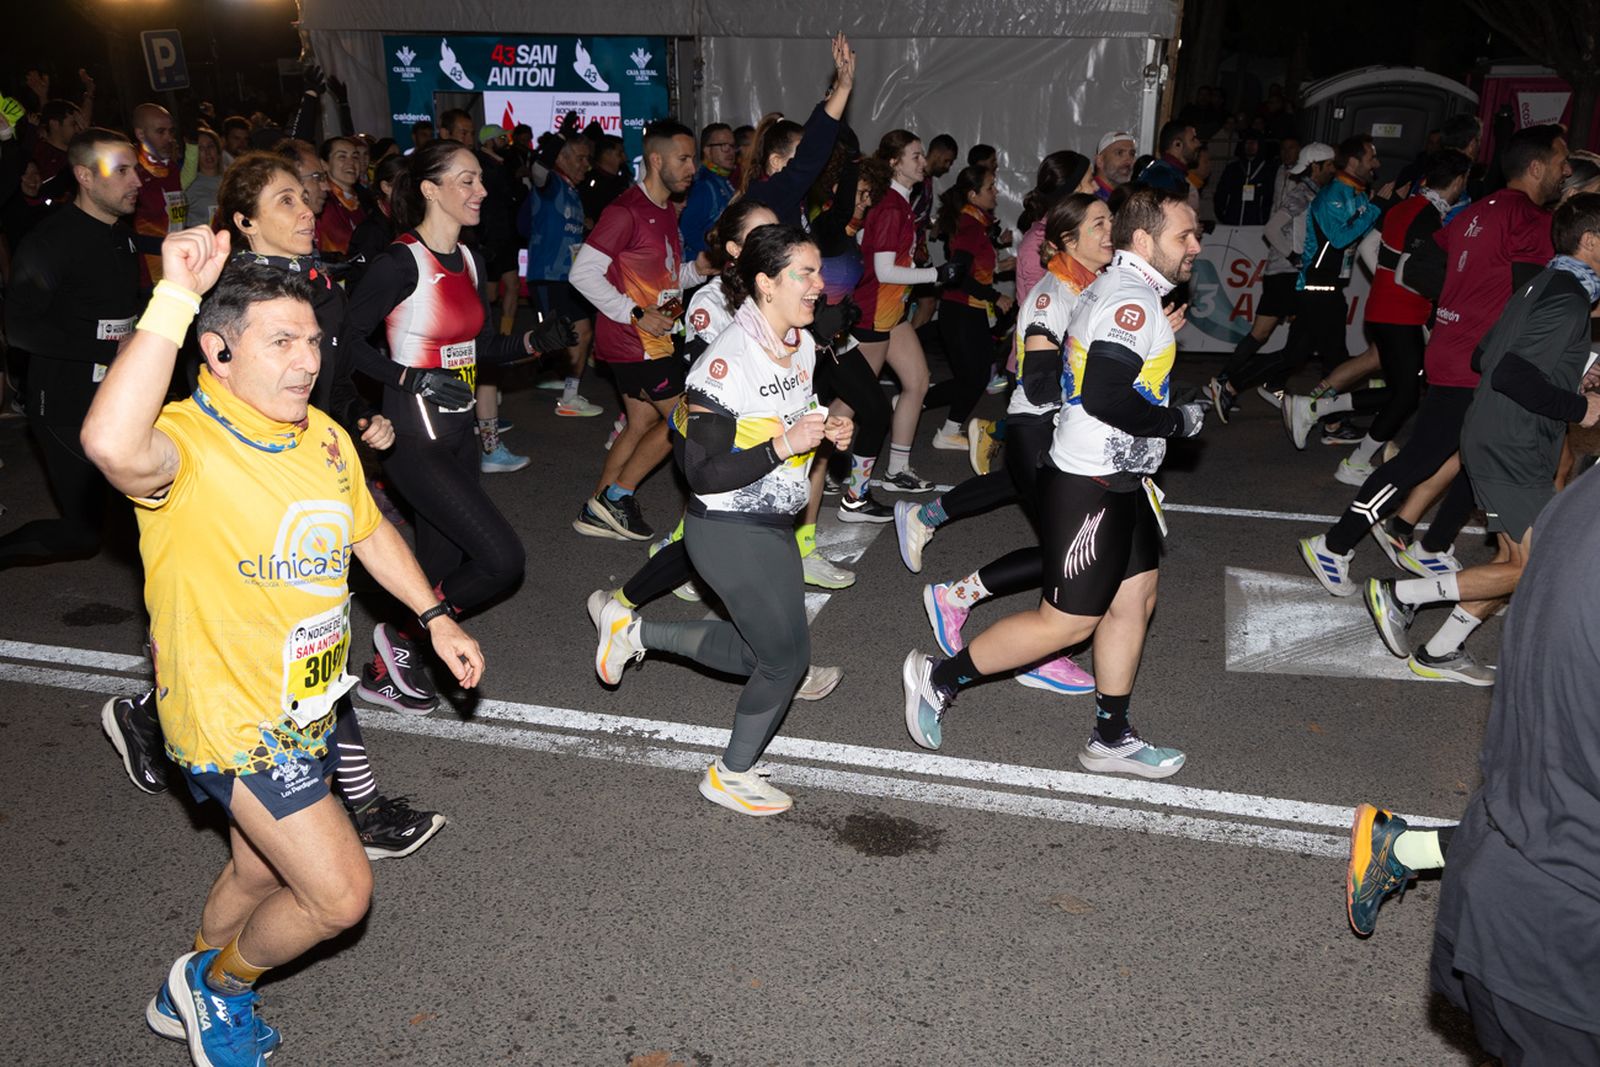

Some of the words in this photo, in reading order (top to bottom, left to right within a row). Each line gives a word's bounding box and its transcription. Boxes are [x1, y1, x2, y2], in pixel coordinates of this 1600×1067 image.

[450, 66, 463, 81] 43
[486, 62, 556, 87] ANTÓN
[583, 68, 598, 83] 43
[393, 112, 431, 121] calderón
[308, 622, 333, 640] NOCHE
[333, 617, 341, 630] DE
[296, 642, 315, 659] SAN
[193, 990, 213, 1032] HOKA
